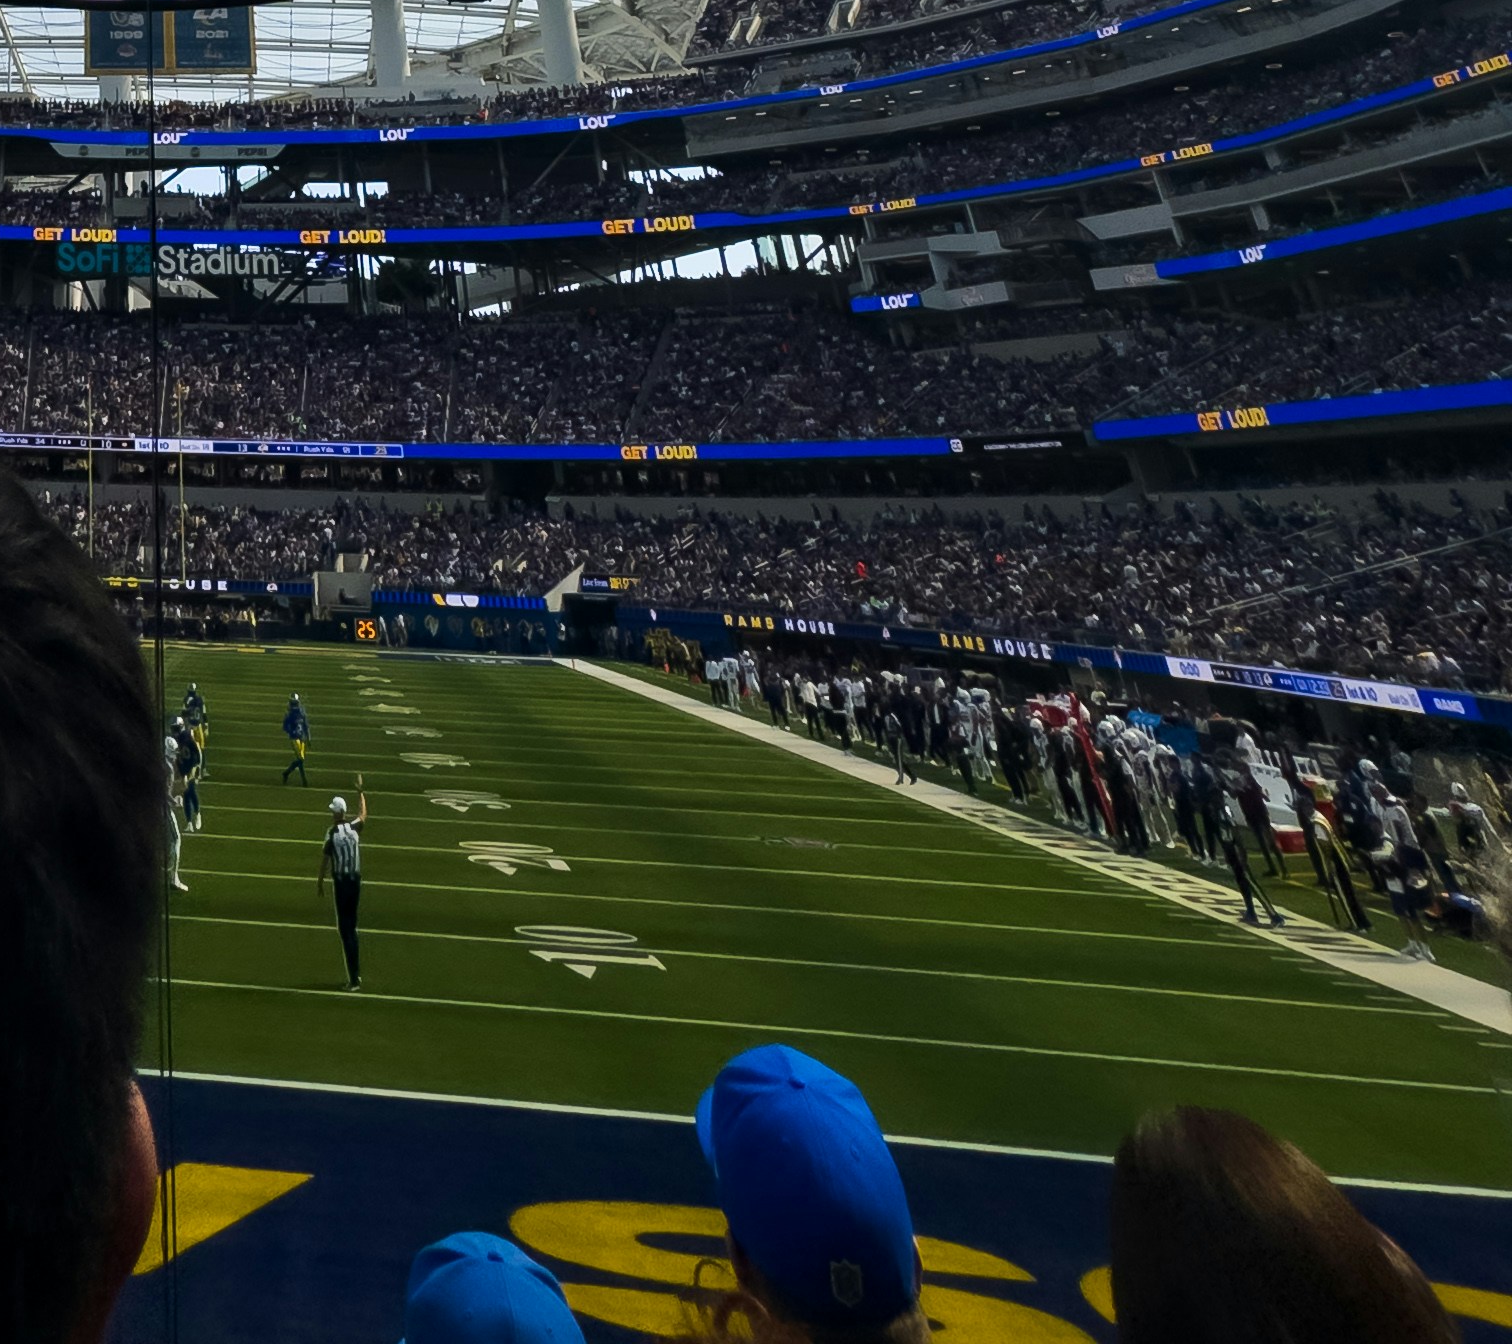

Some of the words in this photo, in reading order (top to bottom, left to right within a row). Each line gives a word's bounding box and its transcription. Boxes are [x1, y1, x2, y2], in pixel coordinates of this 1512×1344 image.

[33, 228, 64, 240] GET
[72, 227, 117, 242] LOUD!
[602, 219, 635, 235] GET
[644, 215, 696, 232] LOUD!
[300, 230, 331, 244] GET
[339, 229, 386, 244] LOUD!
[58, 243, 119, 274] SoFi
[158, 245, 279, 275] Stadium
[1198, 411, 1223, 431] GET
[1227, 407, 1269, 429] LOUD!
[101, 440, 112, 448] 10
[620, 445, 648, 459] GET
[655, 445, 697, 459] LOUD!
[357, 620, 376, 639] 25
[724, 614, 774, 629] RAMS
[784, 618, 835, 635] HOUSE
[940, 633, 985, 652] RAMS
